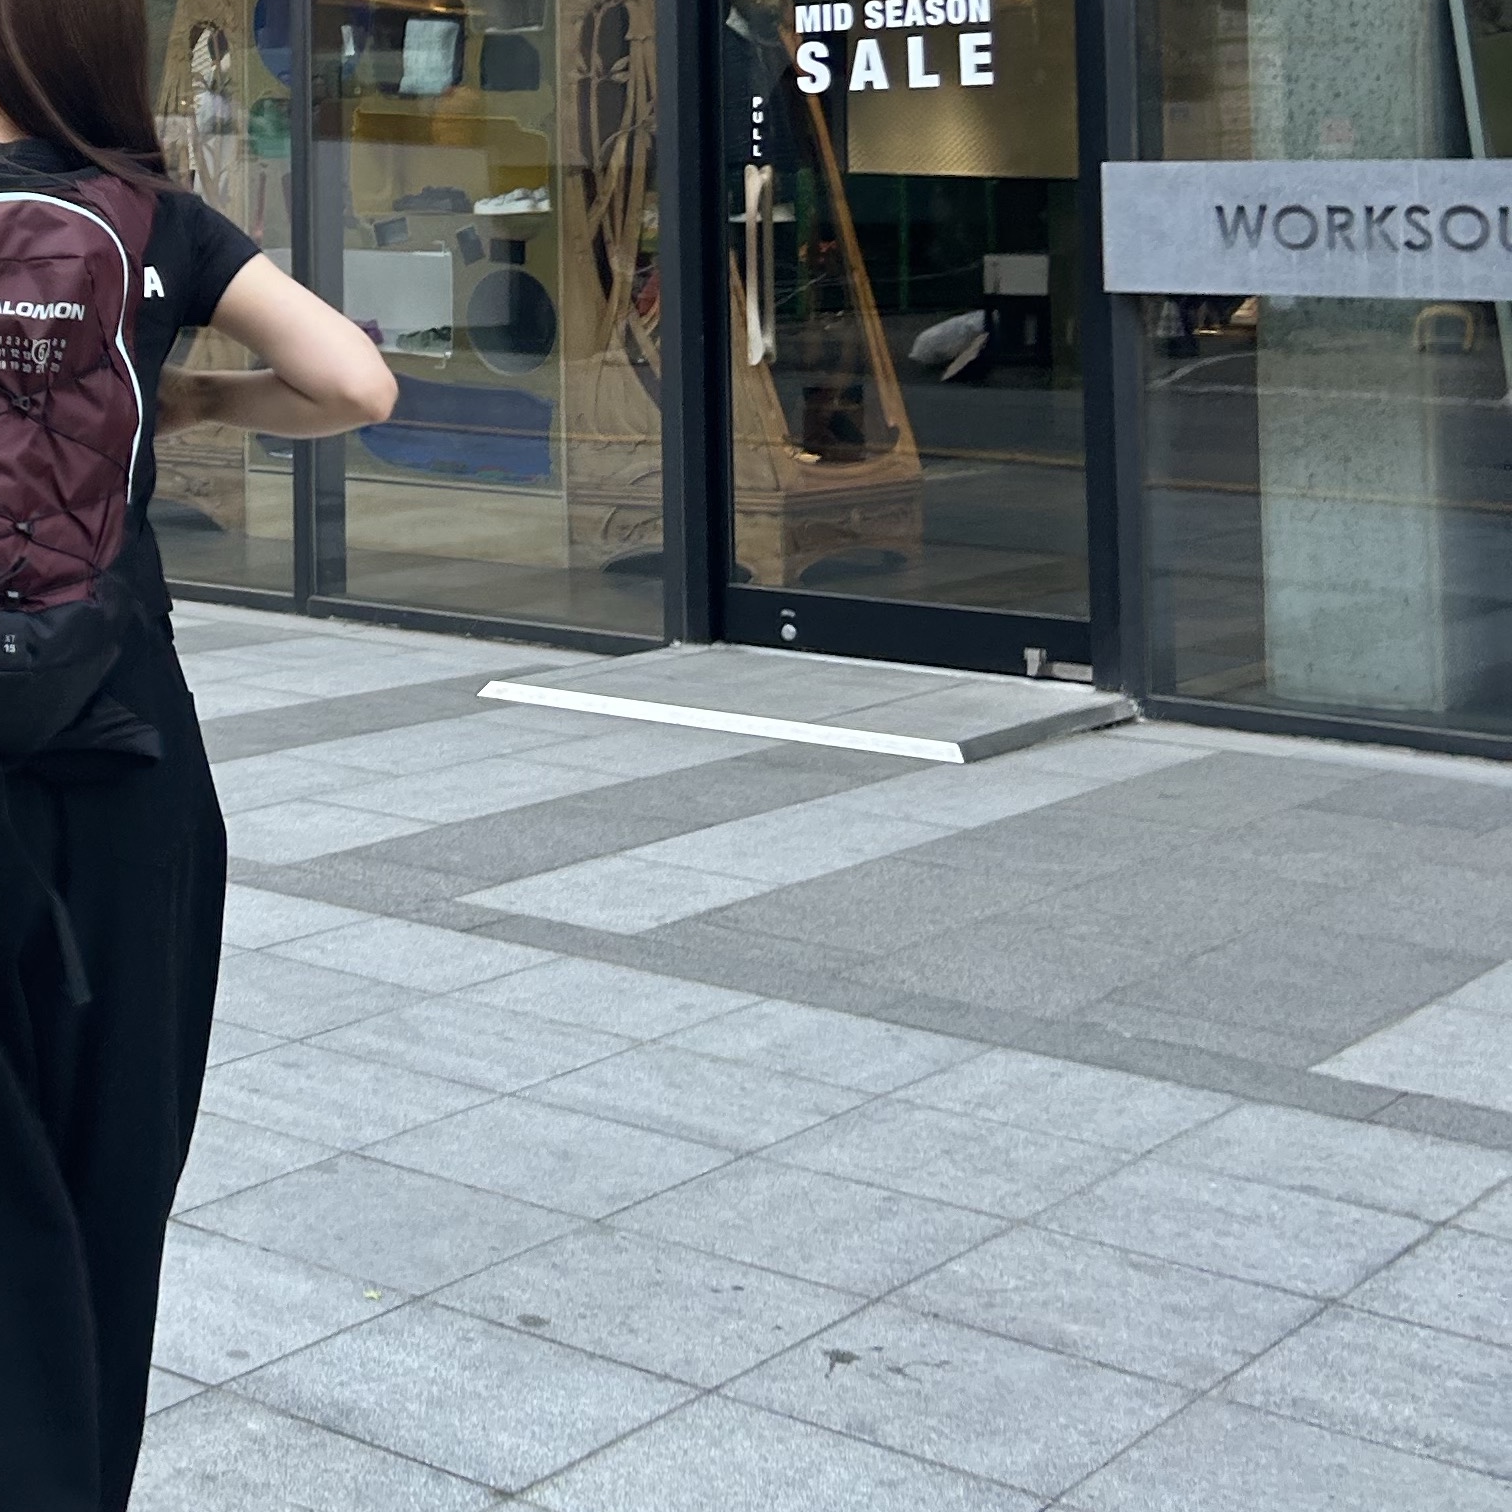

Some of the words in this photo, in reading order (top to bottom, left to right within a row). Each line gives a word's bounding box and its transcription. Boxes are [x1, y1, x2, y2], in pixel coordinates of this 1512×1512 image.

[794, 2, 854, 34] MID
[796, 31, 995, 94] SALE
[752, 95, 764, 157] PULL
[3, 643, 16, 653] 15
